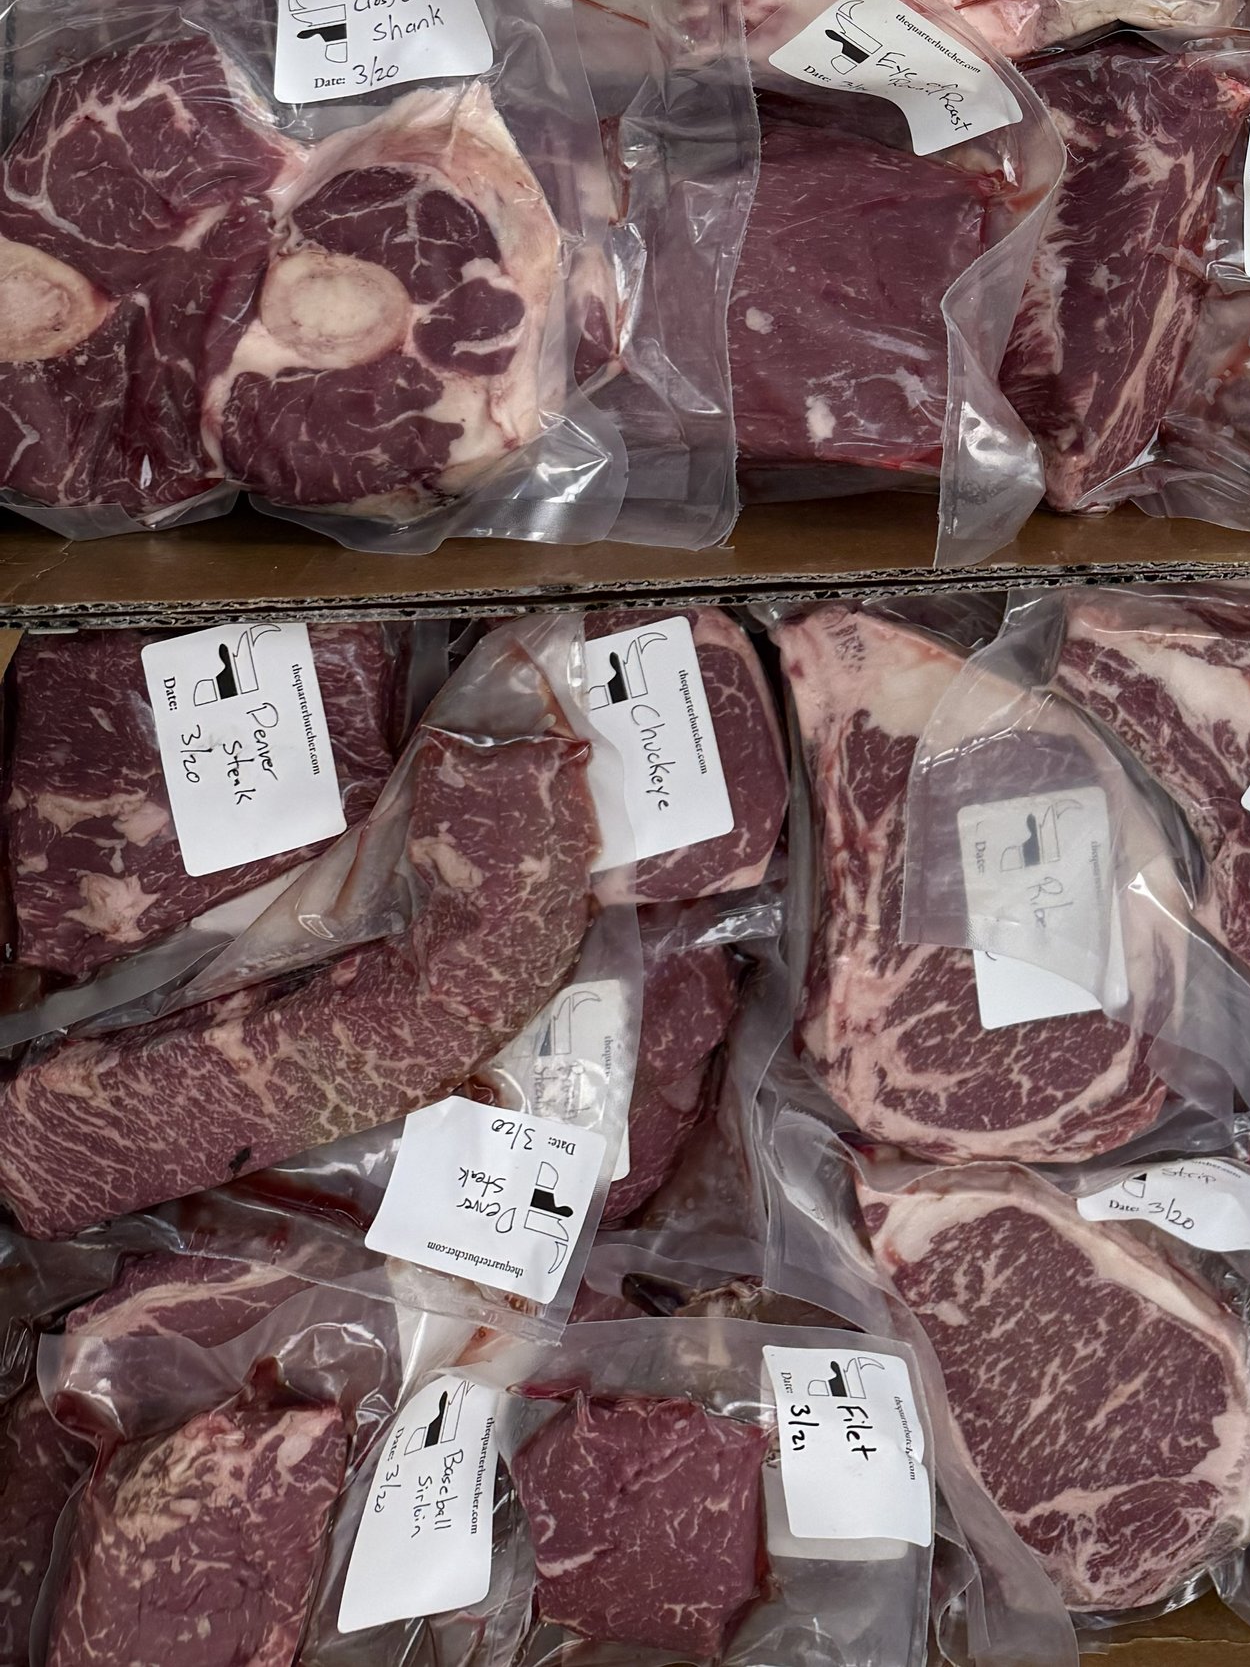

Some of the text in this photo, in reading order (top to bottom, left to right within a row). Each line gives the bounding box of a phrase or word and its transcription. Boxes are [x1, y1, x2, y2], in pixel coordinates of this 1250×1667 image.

[372, 5, 445, 41] Shank
[895, 13, 981, 74] thequarterbutcher.com
[314, 56, 400, 89] Date: 3/20
[803, 65, 832, 82] Date:
[876, 52, 917, 79] Eye
[939, 92, 972, 131] Roast
[163, 676, 213, 783] Date: 3/20
[246, 702, 279, 781] Denver
[291, 663, 320, 775] thequarterbutcher.com
[678, 669, 708, 775] thequarterbutcher.com
[491, 1119, 575, 1155] Date: 3/20
[456, 1197, 517, 1234] Denver
[1109, 1198, 1195, 1230] Date: 3/20
[427, 1240, 524, 1277] thequarterbutcher.com
[788, 1404, 820, 1451] 3/21
[837, 1405, 877, 1461] Filet
[374, 1427, 404, 1513] Date: 3/20
[434, 1449, 463, 1530] Baseball
[470, 1417, 494, 1534] thequarterbutcher.com
[411, 1475, 432, 1538] Sirloin
